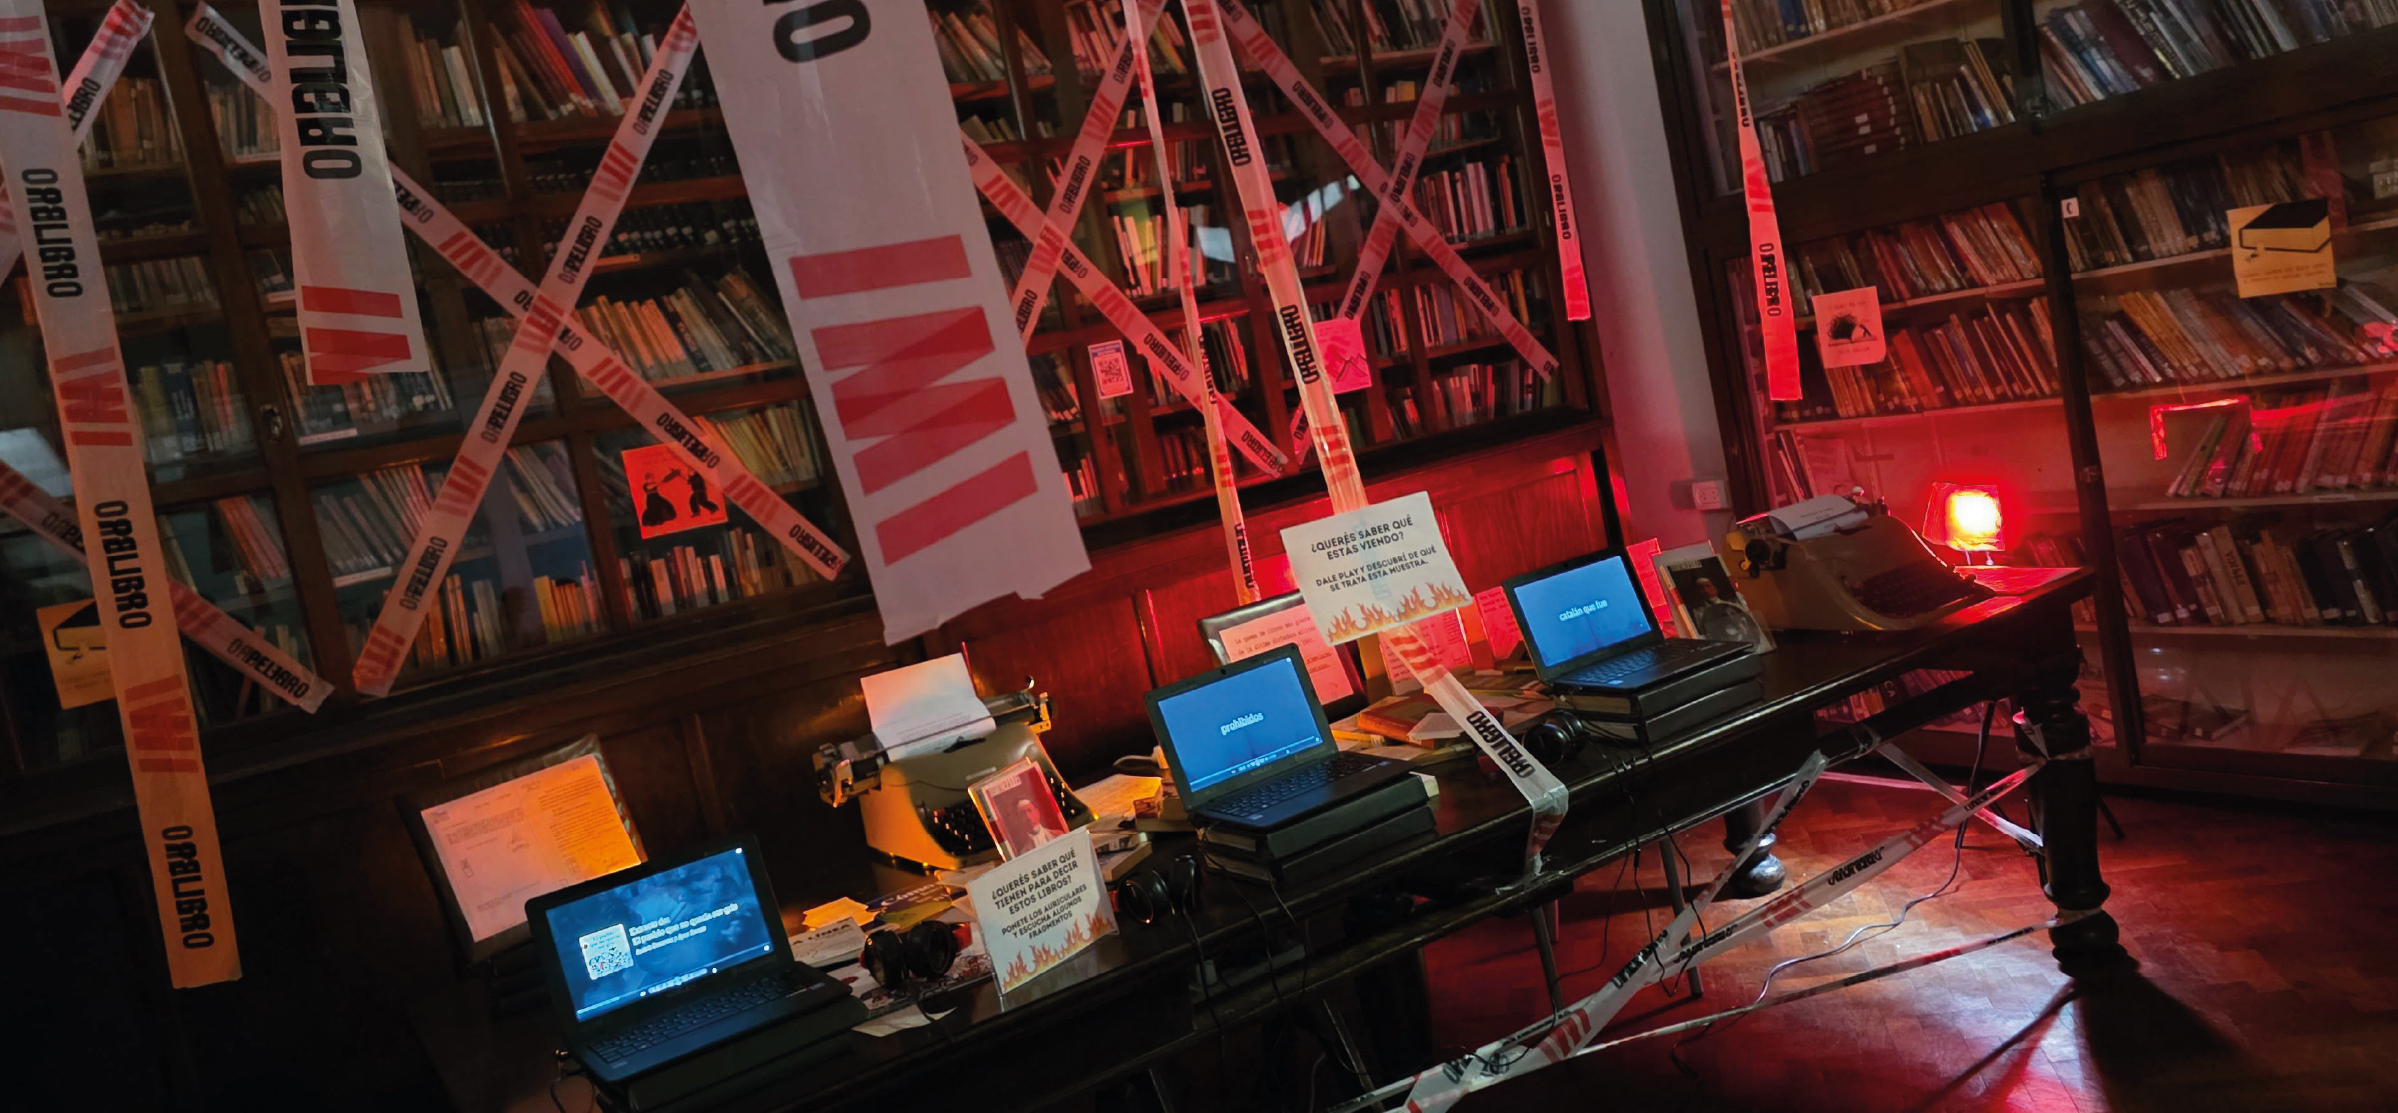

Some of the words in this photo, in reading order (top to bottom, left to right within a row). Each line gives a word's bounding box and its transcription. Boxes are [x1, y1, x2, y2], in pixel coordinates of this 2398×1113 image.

[1311, 532, 1356, 552] ¿QUERÉS
[1358, 523, 1390, 542] SABER
[1392, 515, 1413, 530] QUÉ
[1327, 542, 1359, 560] ESTÁS
[1360, 532, 1404, 551] VIENDO?
[1316, 573, 1337, 586] DALE
[1339, 569, 1358, 581] PLAY
[1366, 552, 1407, 572] DESCUBRÍ
[1409, 551, 1418, 560] DE
[1420, 544, 1437, 556] QUÉ
[1330, 584, 1341, 592] SE
[1342, 577, 1367, 588] TRATA
[1368, 570, 1388, 581] ESTA
[1220, 711, 1264, 735] prohibidos
[992, 873, 1030, 899] ¿QUERÉS
[1031, 859, 1058, 879] SABER
[1060, 848, 1076, 864] QUÉ
[995, 888, 1027, 910] TIENEN
[1029, 875, 1052, 895] PARA
[1053, 861, 1078, 880] DECIR
[1002, 916, 1028, 935] PONETE
[1029, 909, 1043, 920] LOS
[1044, 884, 1087, 912] AURICULARES
[1009, 894, 1036, 915] ESTOS
[1038, 875, 1072, 900] LIBROS?
[1013, 930, 1018, 938] Y
[1019, 914, 1051, 936] ESCUCHA
[1052, 896, 1082, 919] ALGUNOS
[1029, 911, 1073, 940] FRAGMENTOS
